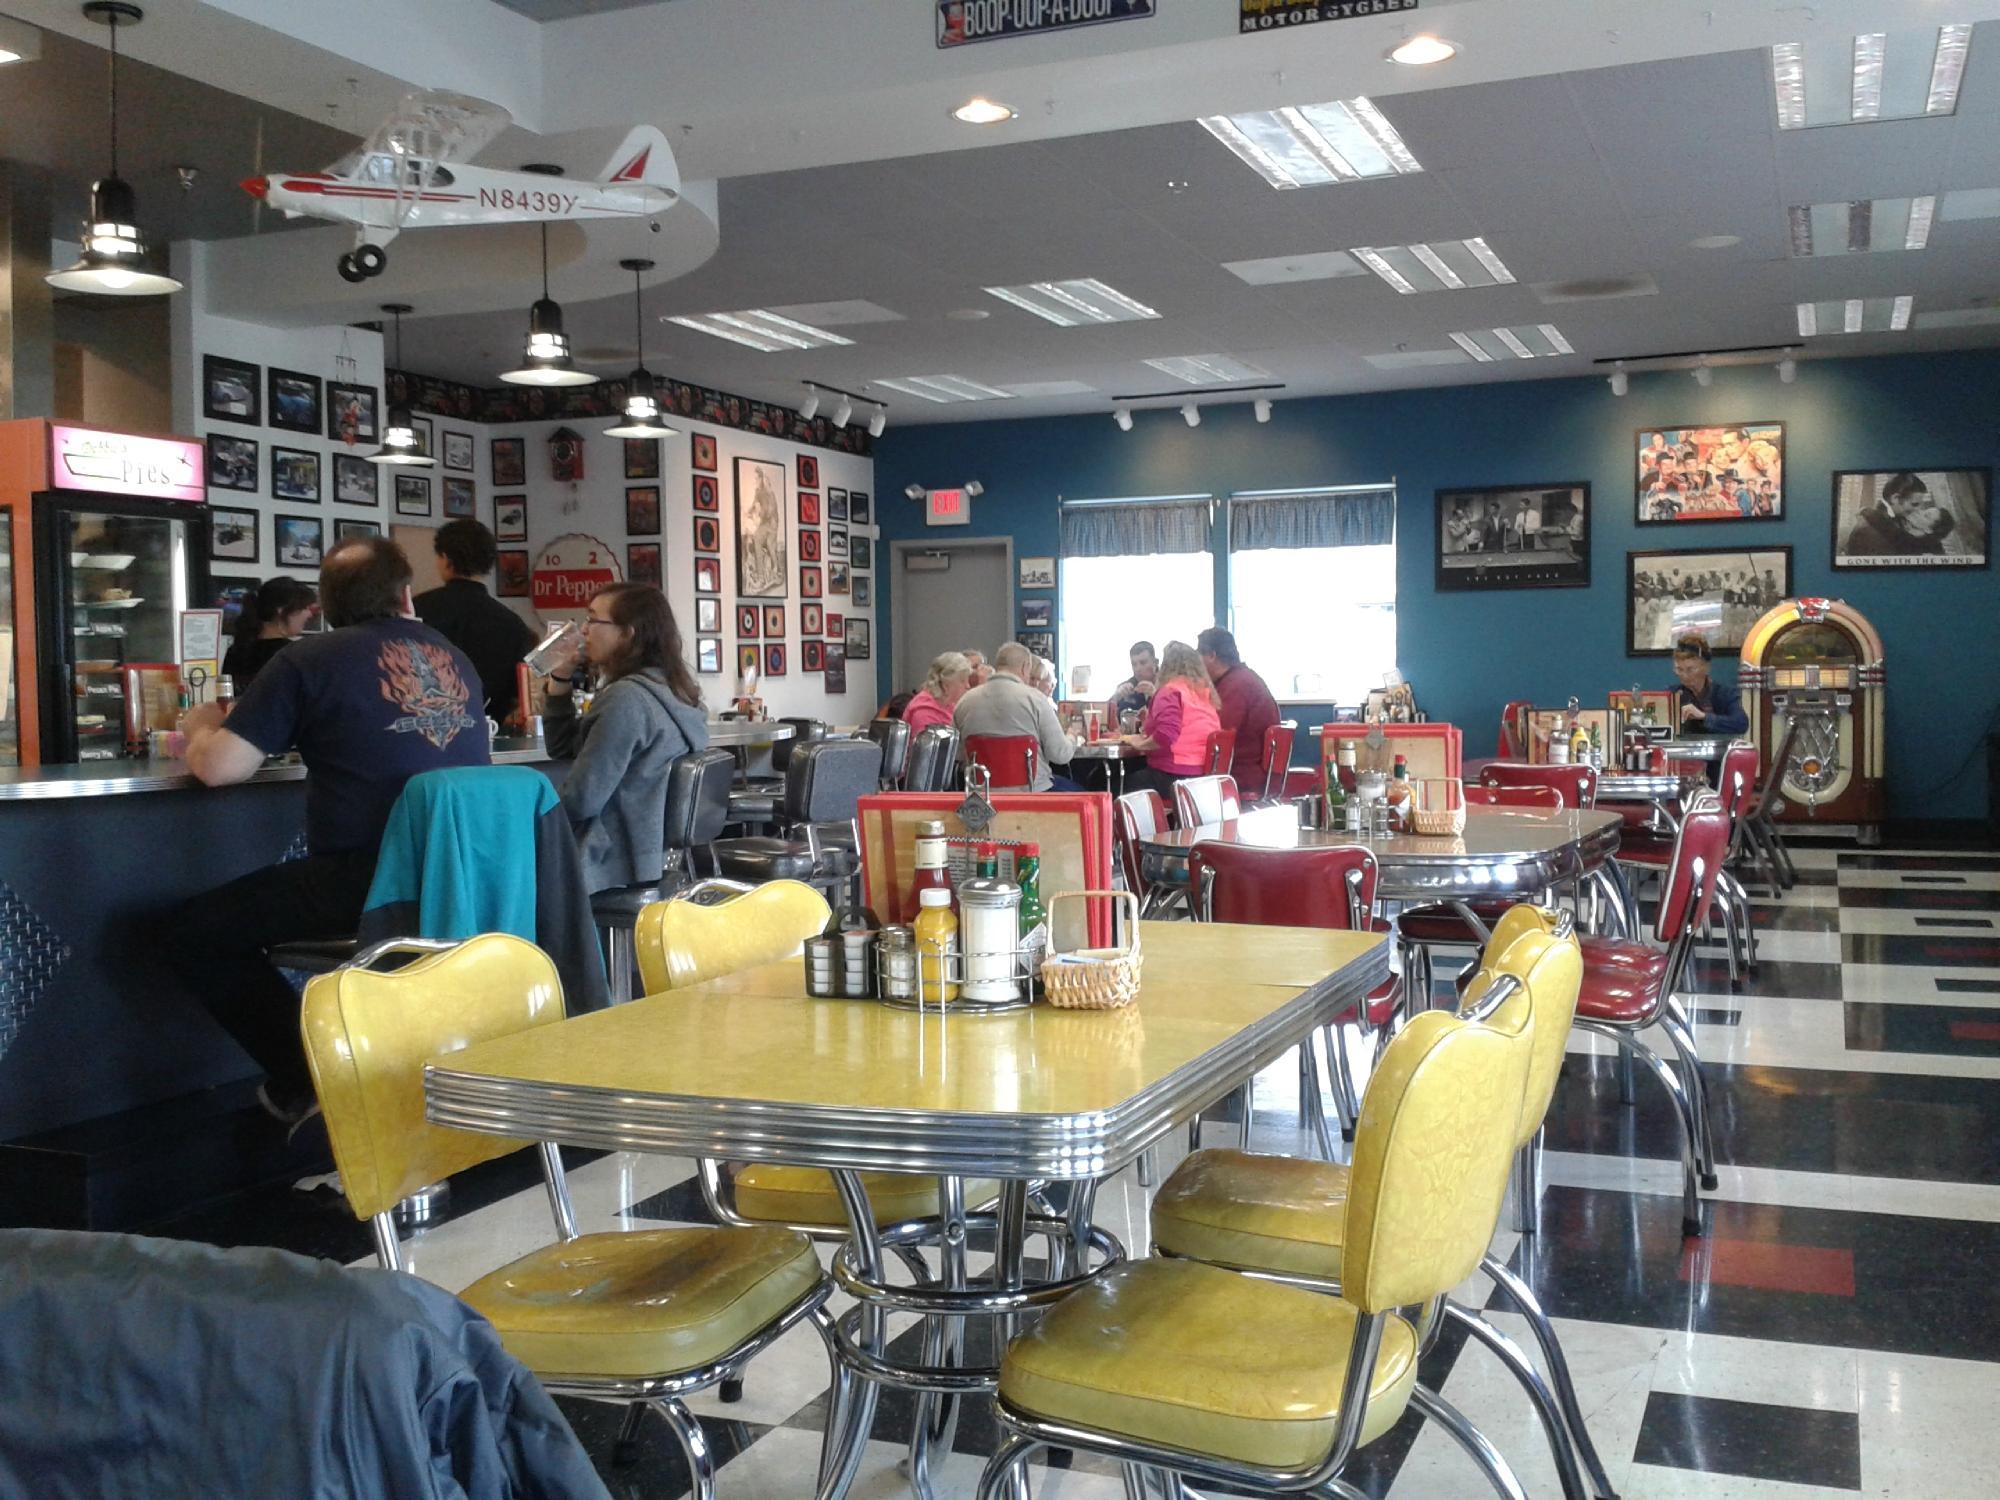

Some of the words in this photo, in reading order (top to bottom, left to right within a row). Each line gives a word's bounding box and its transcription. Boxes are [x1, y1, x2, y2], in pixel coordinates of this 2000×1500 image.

[1242, 8, 1319, 31] MOTOR
[480, 187, 578, 214] N8439Y
[122, 459, 170, 485] Pies
[934, 492, 960, 513] EXIT
[545, 554, 561, 566] 10
[588, 551, 598, 564] 2
[1847, 557, 1877, 565] GONE
[1881, 557, 1912, 565] WITH
[1915, 557, 1935, 565] THE
[1940, 556, 1973, 564] WIND
[534, 579, 553, 596] Dr
[555, 574, 614, 602] Peppe
